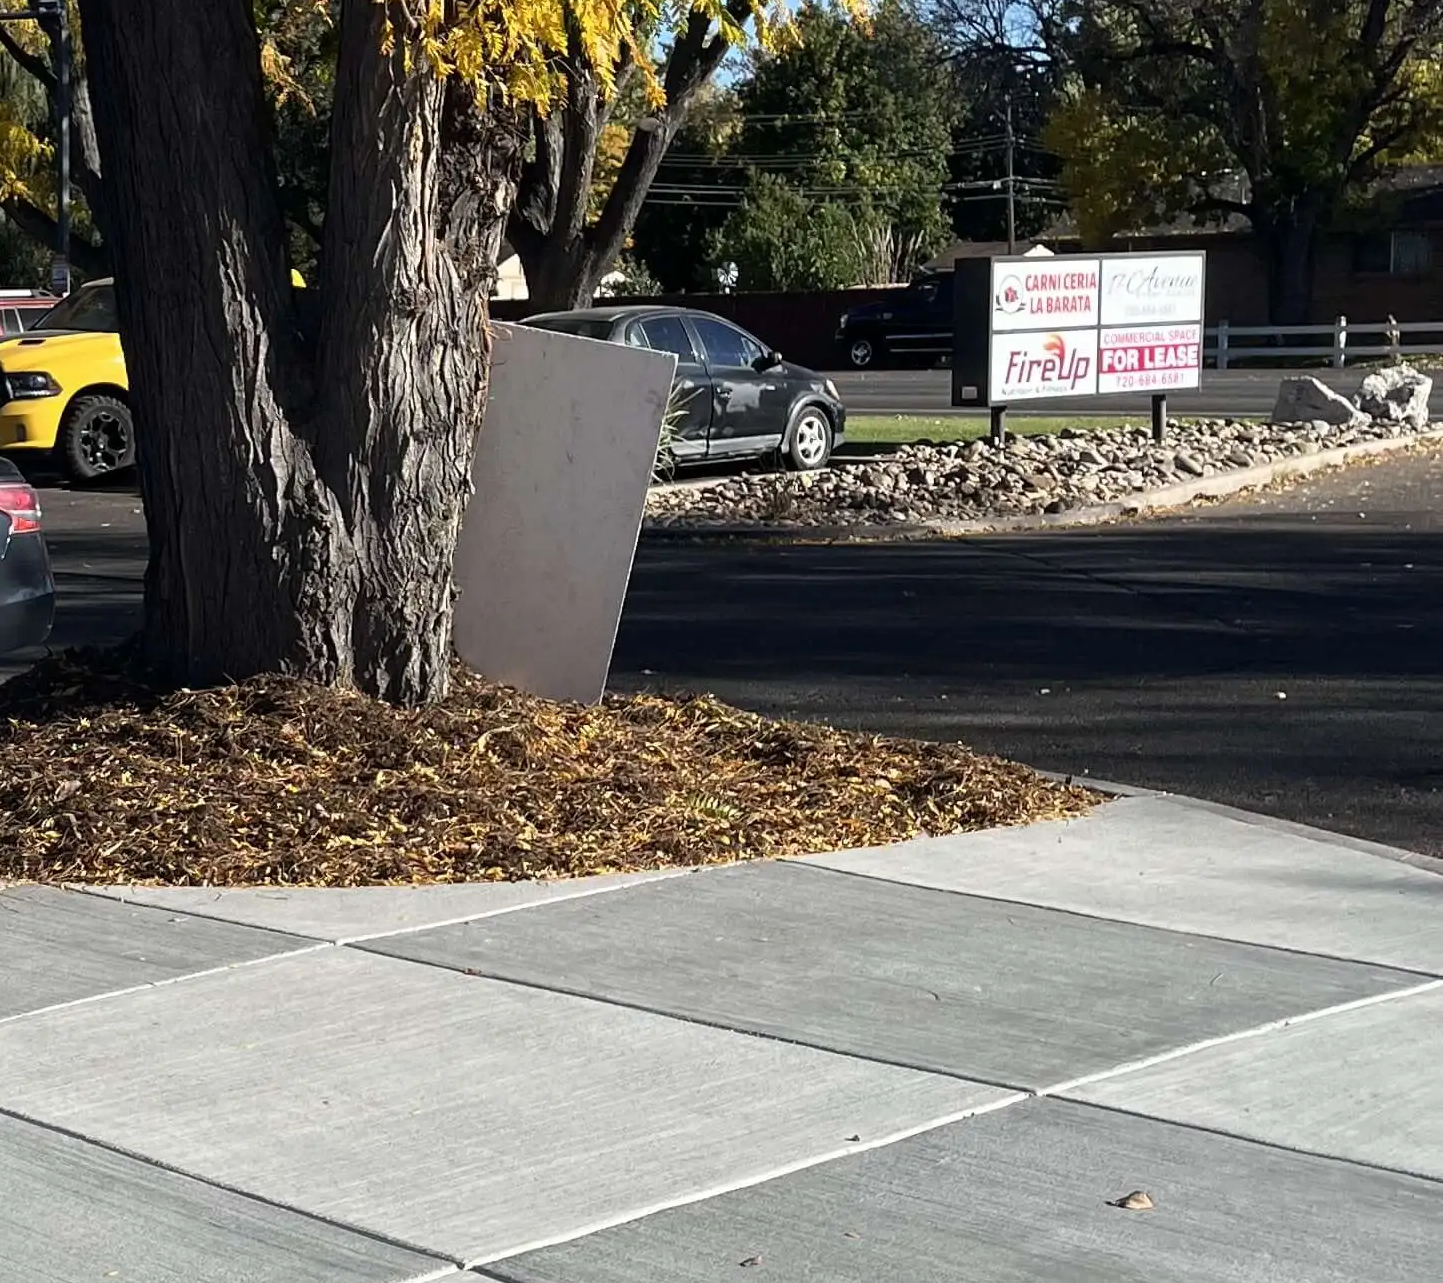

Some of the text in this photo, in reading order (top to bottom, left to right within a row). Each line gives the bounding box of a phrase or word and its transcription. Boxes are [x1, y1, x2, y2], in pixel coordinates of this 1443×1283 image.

[1030, 295, 1091, 315] LA BARATA
[1103, 328, 1197, 345] COMMERCIAL SPACE
[1102, 345, 1198, 372] FOR LEASE
